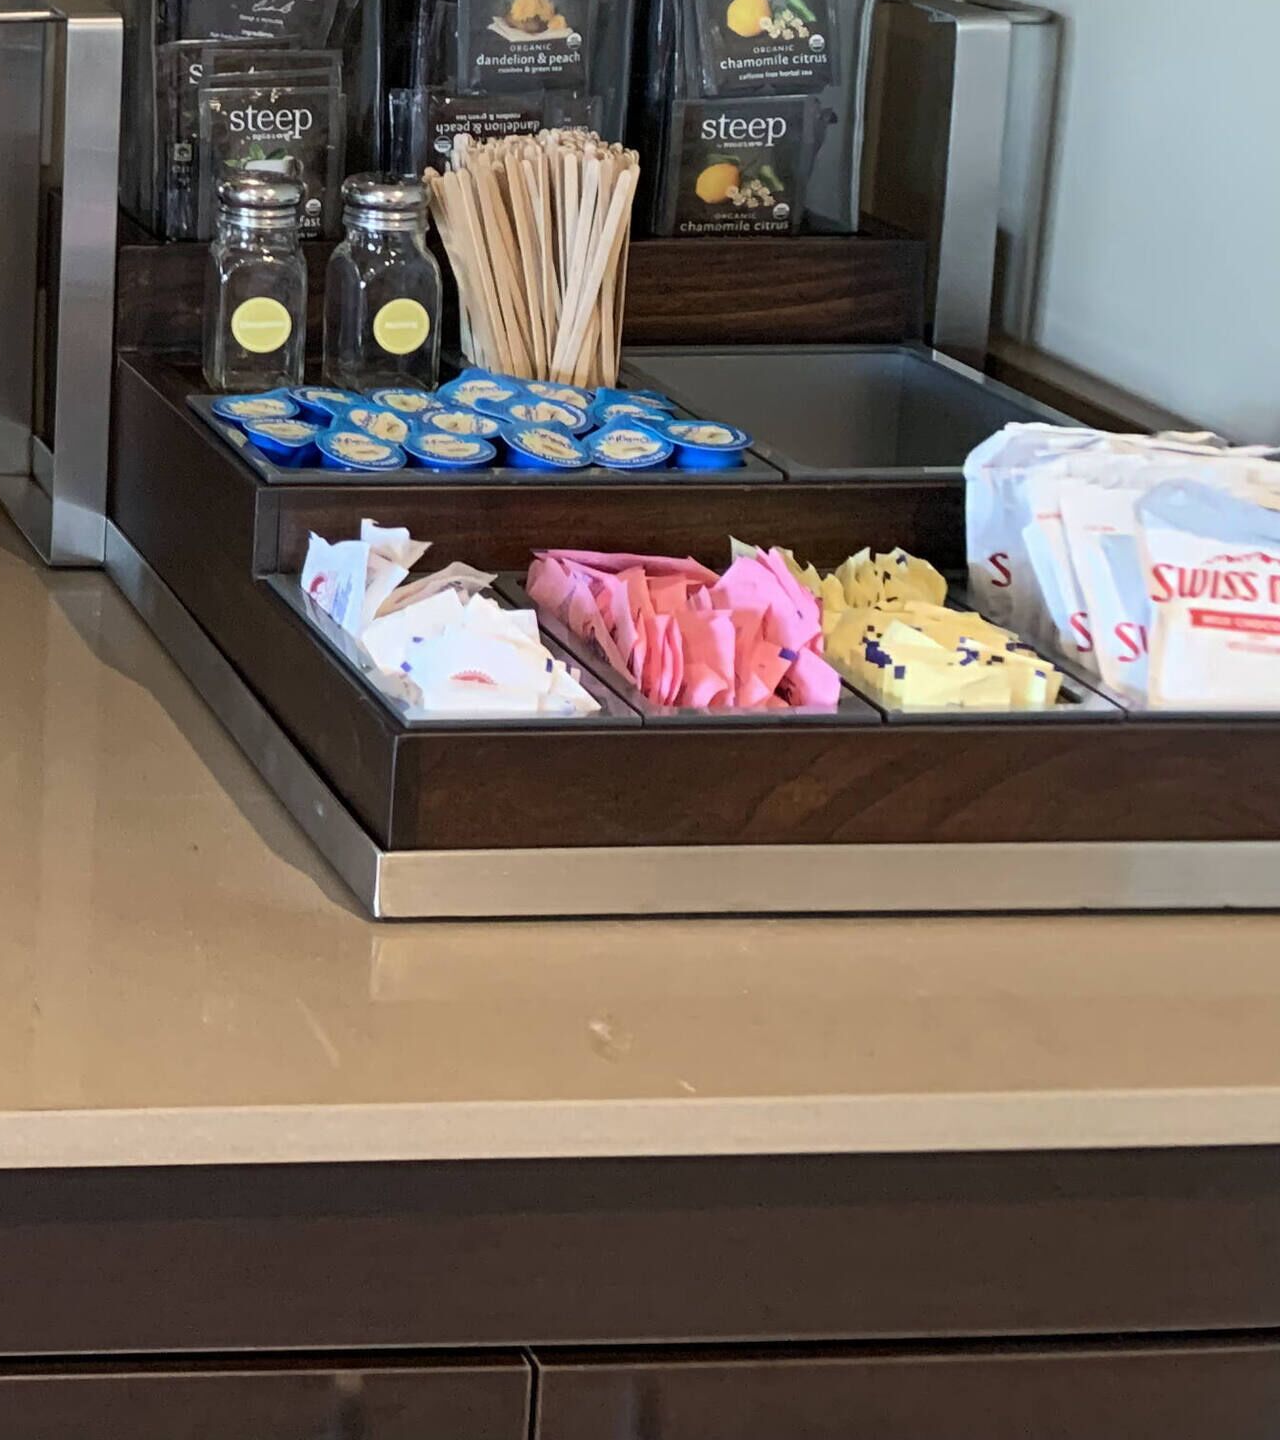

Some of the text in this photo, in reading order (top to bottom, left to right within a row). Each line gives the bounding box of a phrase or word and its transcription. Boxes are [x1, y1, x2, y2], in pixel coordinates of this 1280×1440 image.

[509, 42, 553, 52] ORGANIC
[752, 43, 795, 55] ORGANIC
[476, 50, 581, 66] dandelion & peach
[720, 51, 828, 70] chamomile citrus
[229, 104, 313, 140] steep
[436, 120, 470, 135] peach
[484, 120, 540, 133] dandelion
[700, 113, 787, 147] steep
[679, 219, 789, 233] chamomile citrus
[1151, 563, 1259, 603] SWISS
